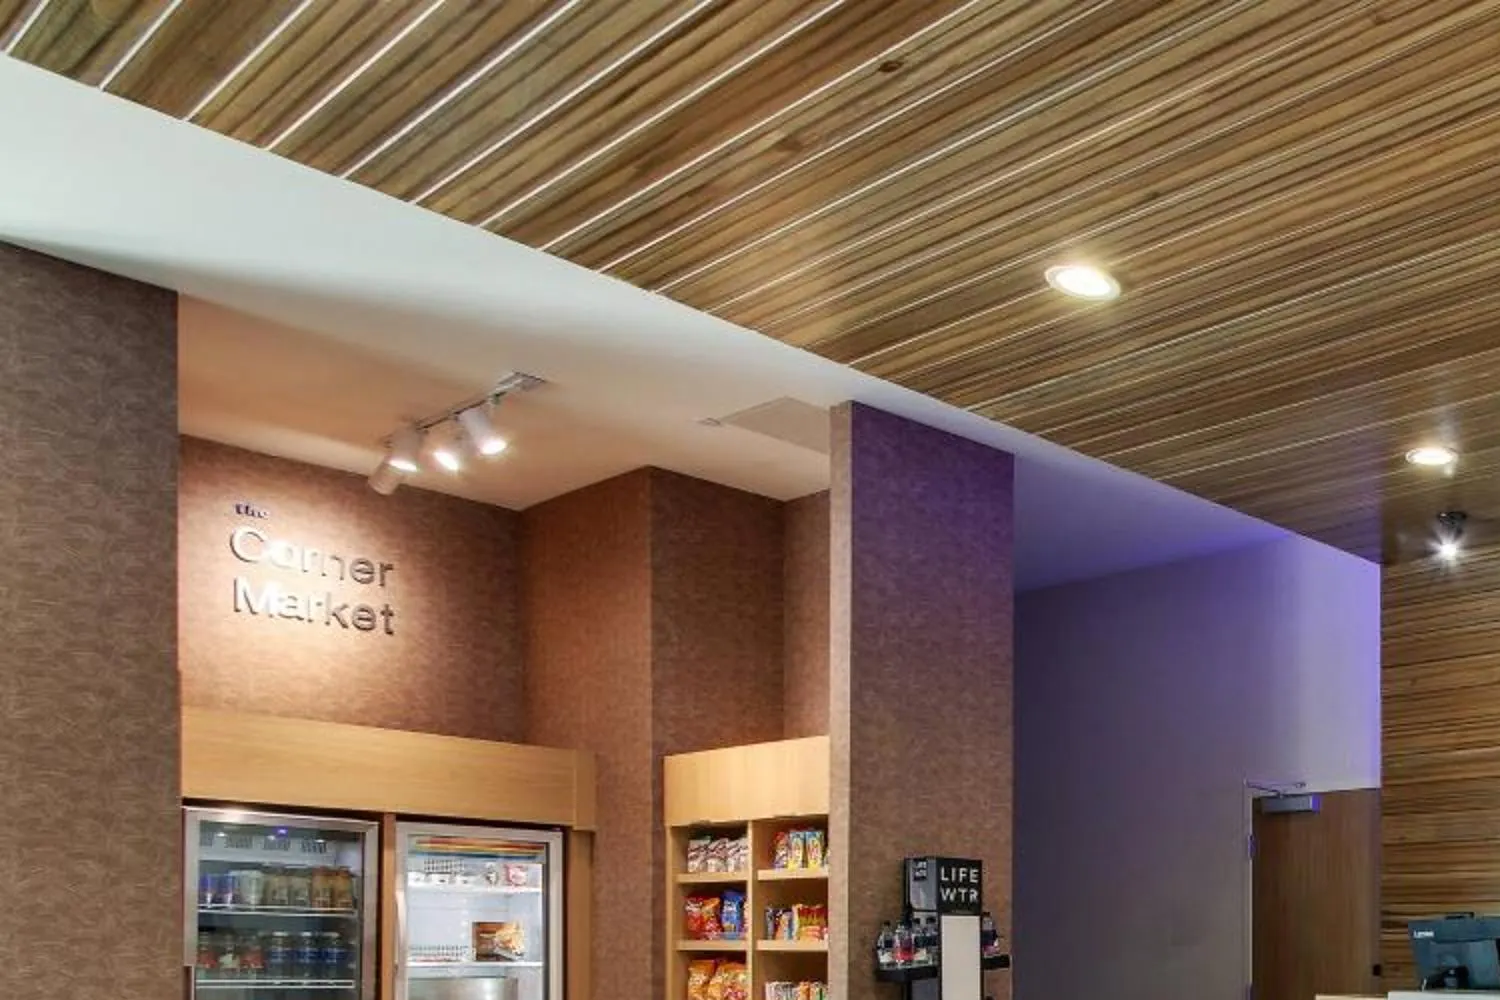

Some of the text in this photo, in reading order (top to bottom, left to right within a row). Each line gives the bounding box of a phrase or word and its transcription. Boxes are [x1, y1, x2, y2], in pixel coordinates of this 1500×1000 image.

[230, 526, 394, 587] Corner
[233, 577, 395, 635] Market
[940, 866, 979, 883] LIFE
[940, 887, 979, 902] WTR
